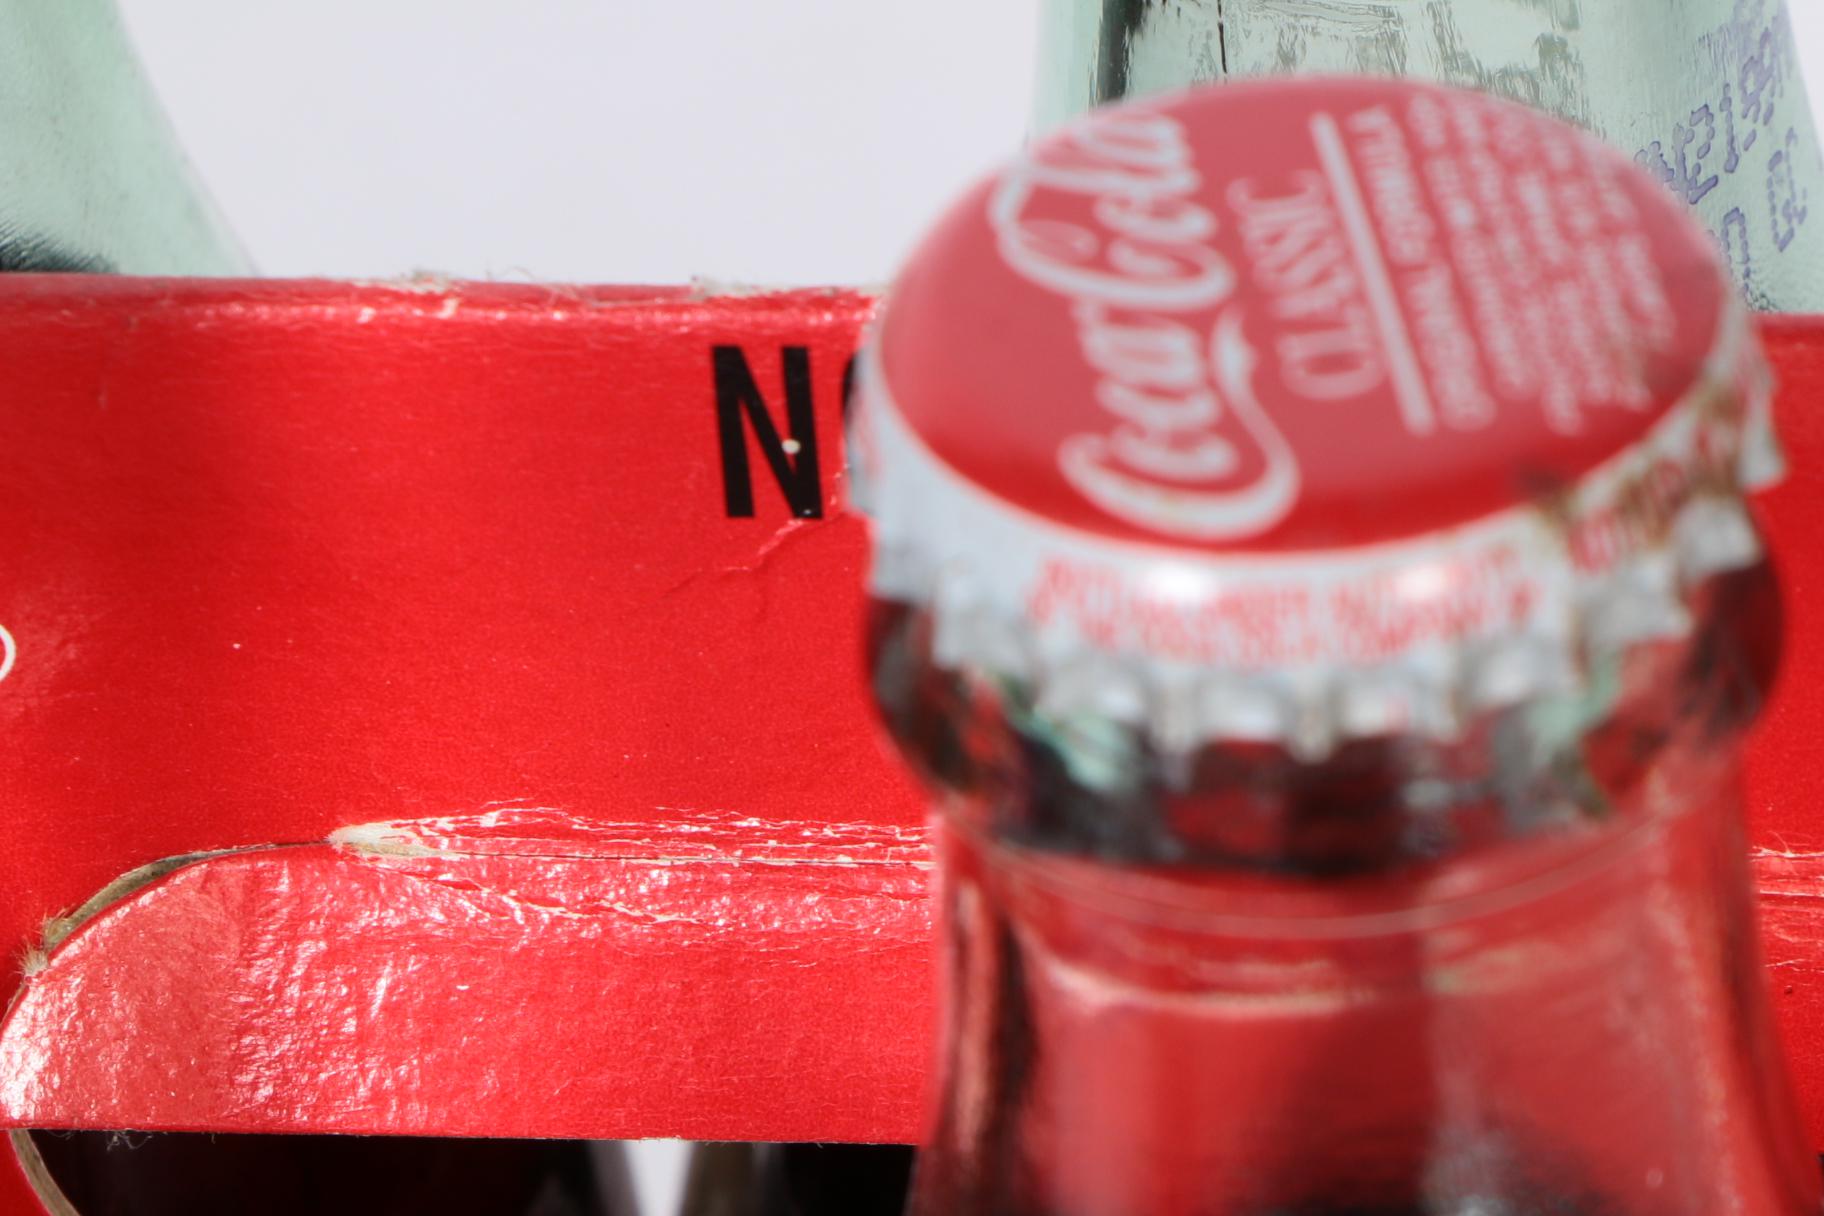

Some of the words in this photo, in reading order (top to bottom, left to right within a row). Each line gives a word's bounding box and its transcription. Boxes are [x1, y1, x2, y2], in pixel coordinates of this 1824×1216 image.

[1350, 105, 1438, 266] FORMULA
[1226, 170, 1386, 400] CLASSIC
[711, 345, 856, 520] N
